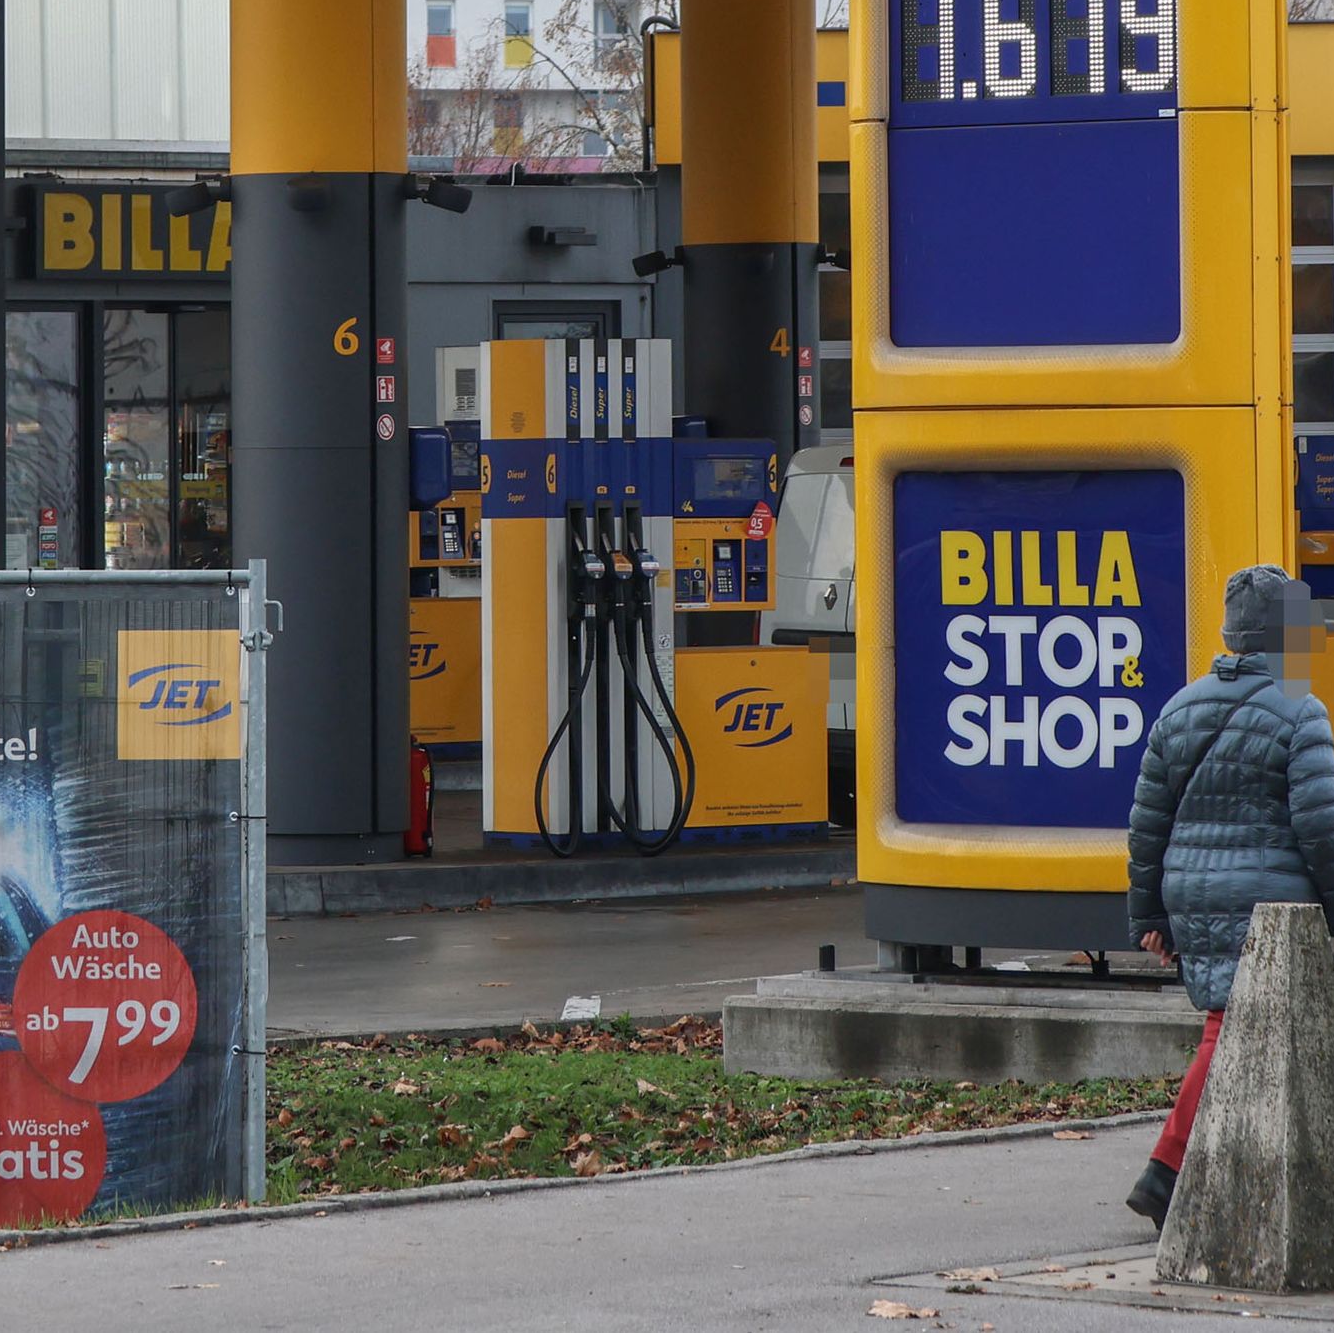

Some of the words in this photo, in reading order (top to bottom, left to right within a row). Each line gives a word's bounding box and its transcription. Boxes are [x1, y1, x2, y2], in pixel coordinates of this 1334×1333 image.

[333, 317, 360, 356] 6
[769, 327, 791, 358] 4
[569, 386, 578, 419] Diesel
[595, 387, 606, 419] Super
[623, 387, 634, 419] Super
[482, 466, 489, 486] 5
[547, 465, 555, 485] 6
[940, 531, 1142, 606] BILLA
[410, 643, 439, 667] ET
[138, 679, 221, 710] JET
[723, 702, 784, 733] JET
[943, 693, 1145, 769] SHOP
[72, 924, 140, 950] Auto
[51, 955, 162, 981] Wäsche
[26, 1005, 59, 1032] ab
